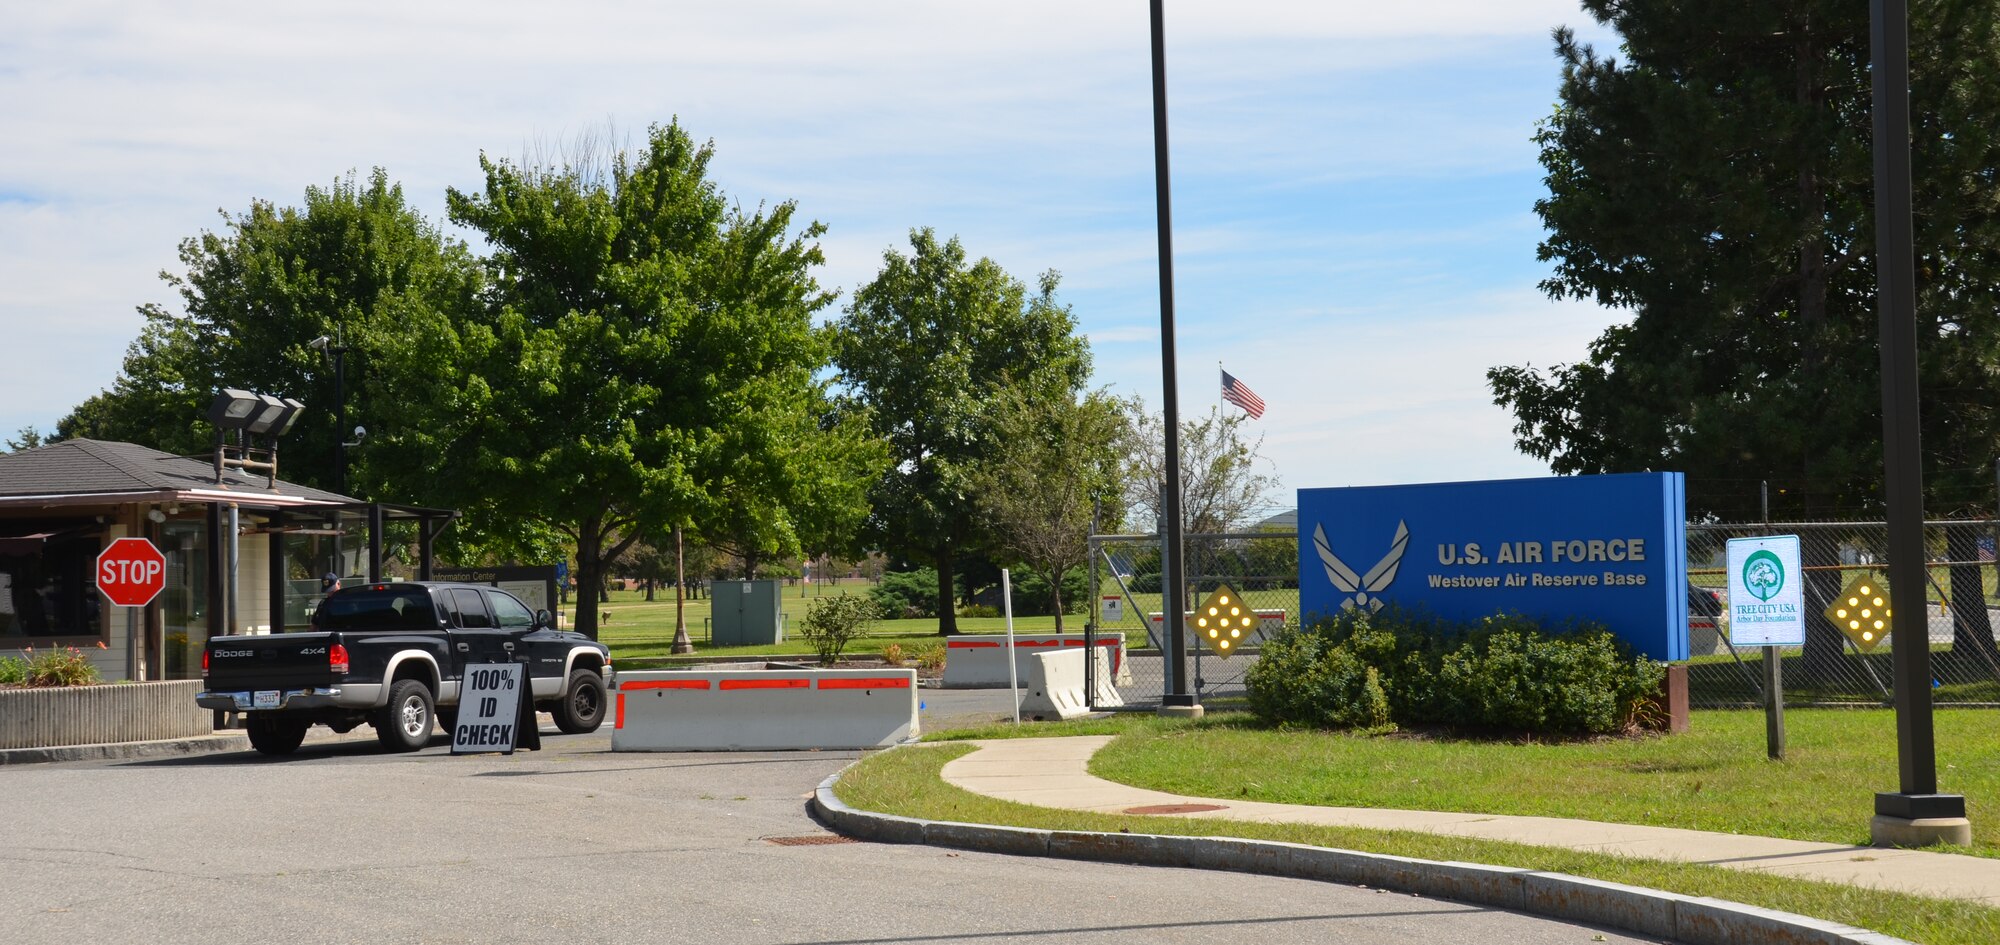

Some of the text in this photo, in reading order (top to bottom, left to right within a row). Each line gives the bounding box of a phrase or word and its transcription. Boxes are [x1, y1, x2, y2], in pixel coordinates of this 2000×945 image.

[1437, 538, 1645, 566] U.S. AIR FORCE
[101, 559, 161, 585] STOP
[432, 571, 496, 582] Information Center
[1428, 571, 1646, 588] Westover Air Reserve Base
[1736, 603, 1796, 615] TREE CITY USA
[1736, 613, 1797, 623] Arbor Day Foundation
[214, 649, 254, 658] DODGE
[470, 669, 514, 690] 100%
[478, 697, 498, 718] ID
[456, 724, 512, 746] CHECK
